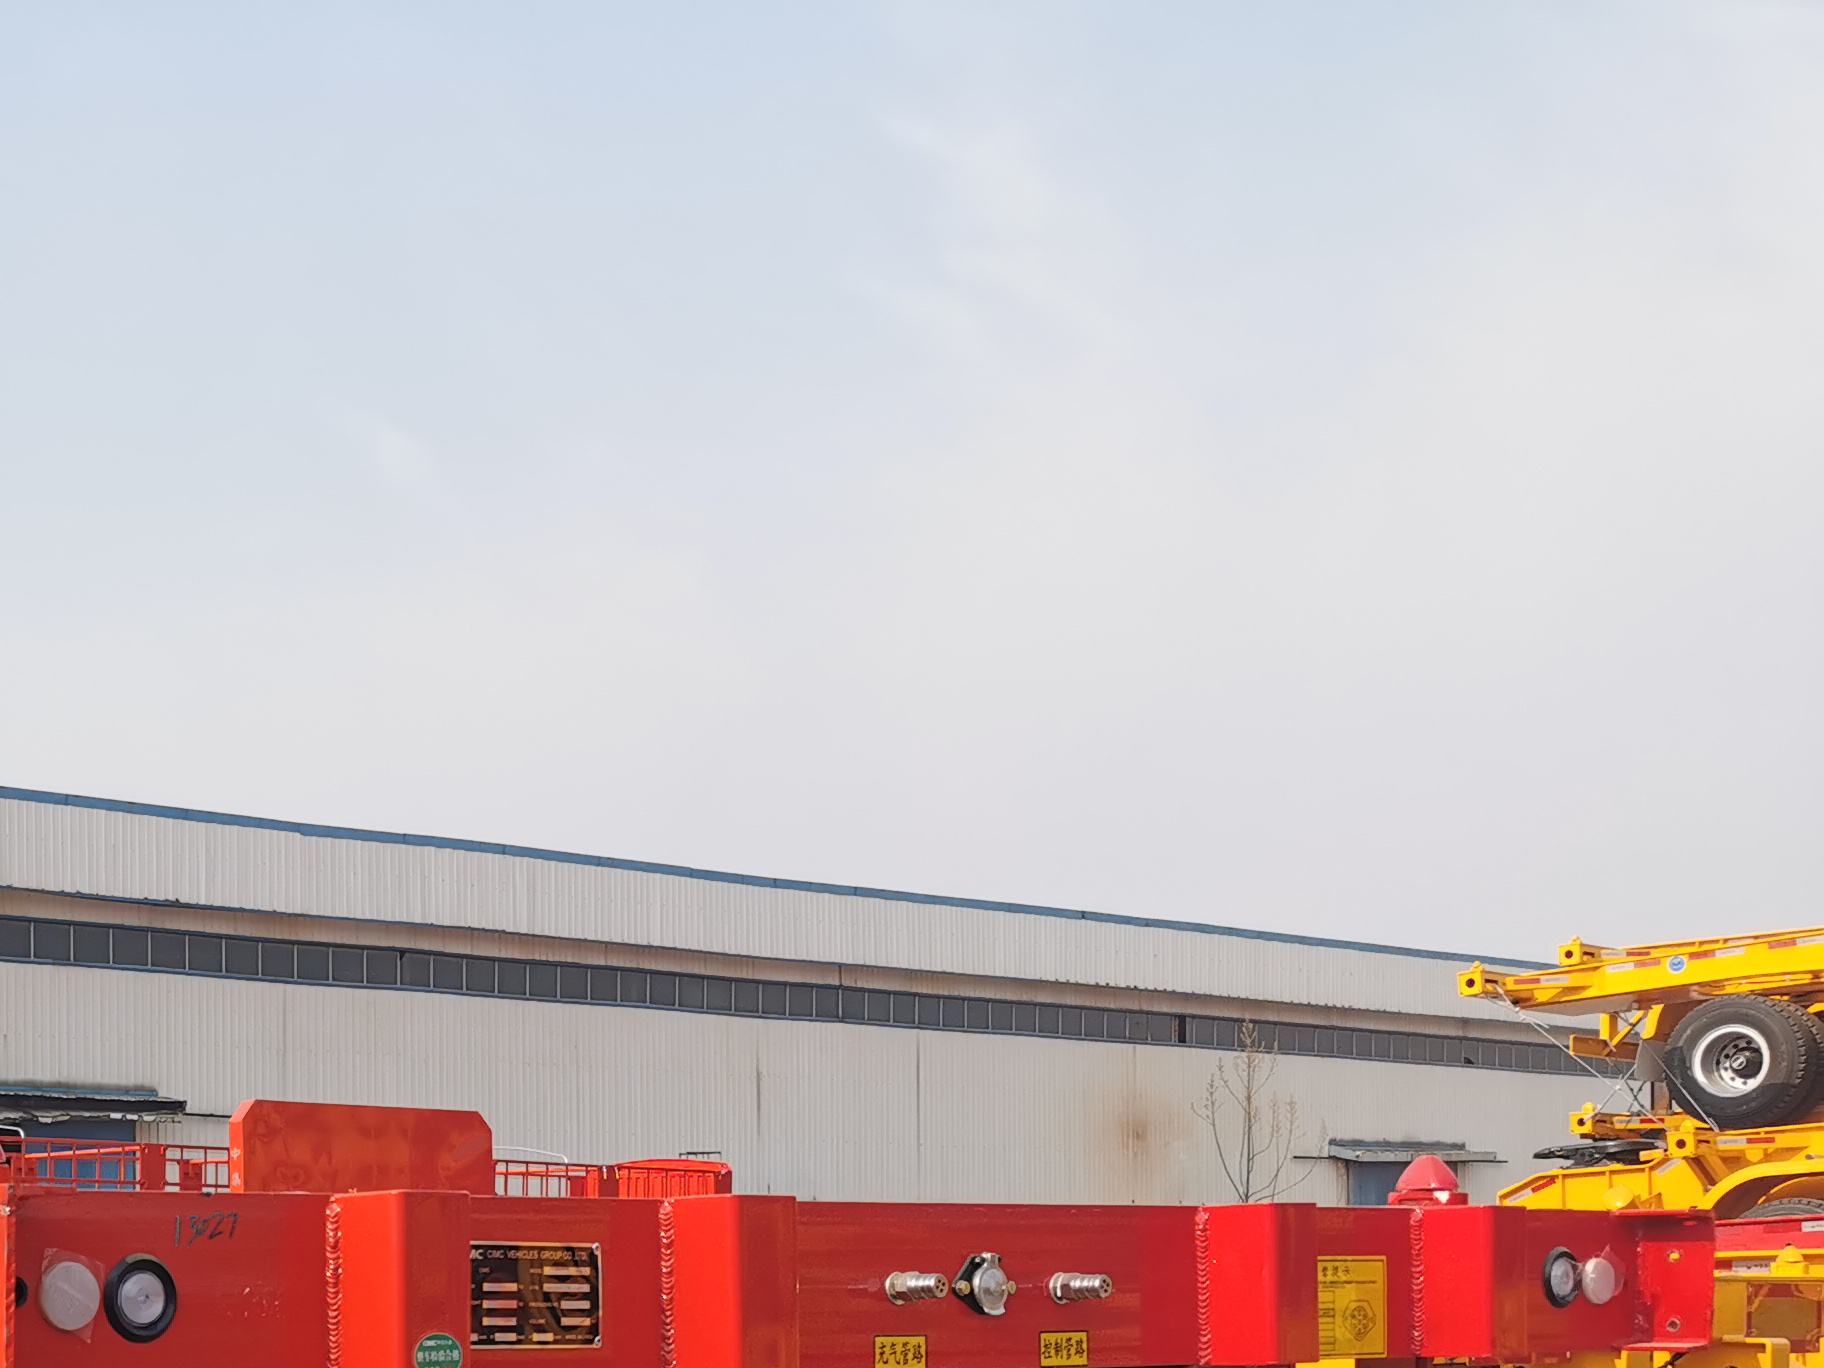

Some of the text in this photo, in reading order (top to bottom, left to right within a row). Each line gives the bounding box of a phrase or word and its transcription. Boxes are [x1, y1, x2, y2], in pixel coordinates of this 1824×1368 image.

[507, 1250, 538, 1260] VEHICLES
[876, 1341, 924, 1366] 充气管路
[1041, 1337, 1086, 1361] 控制管路
